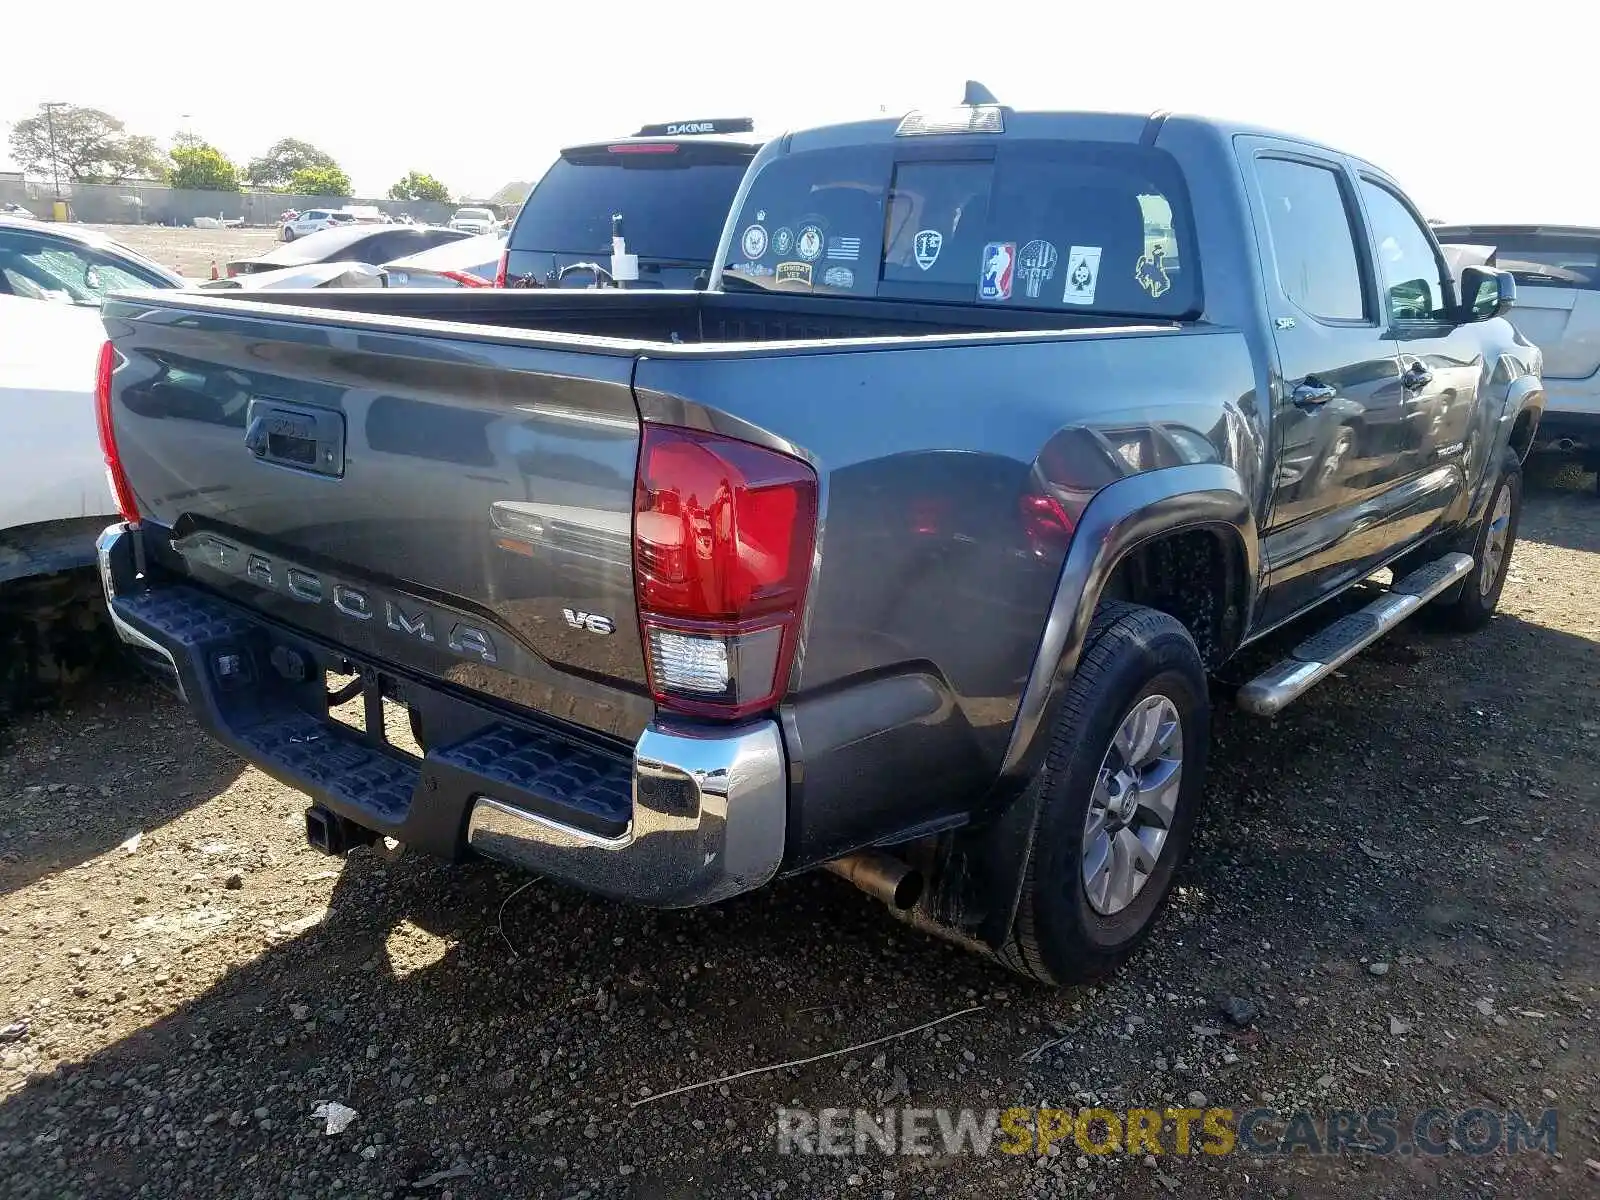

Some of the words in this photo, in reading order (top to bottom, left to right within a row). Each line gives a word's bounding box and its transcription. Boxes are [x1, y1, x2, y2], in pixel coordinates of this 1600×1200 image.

[667, 122, 715, 135] DAKINE
[207, 536, 498, 663] TACOMA
[561, 606, 617, 635] V6
